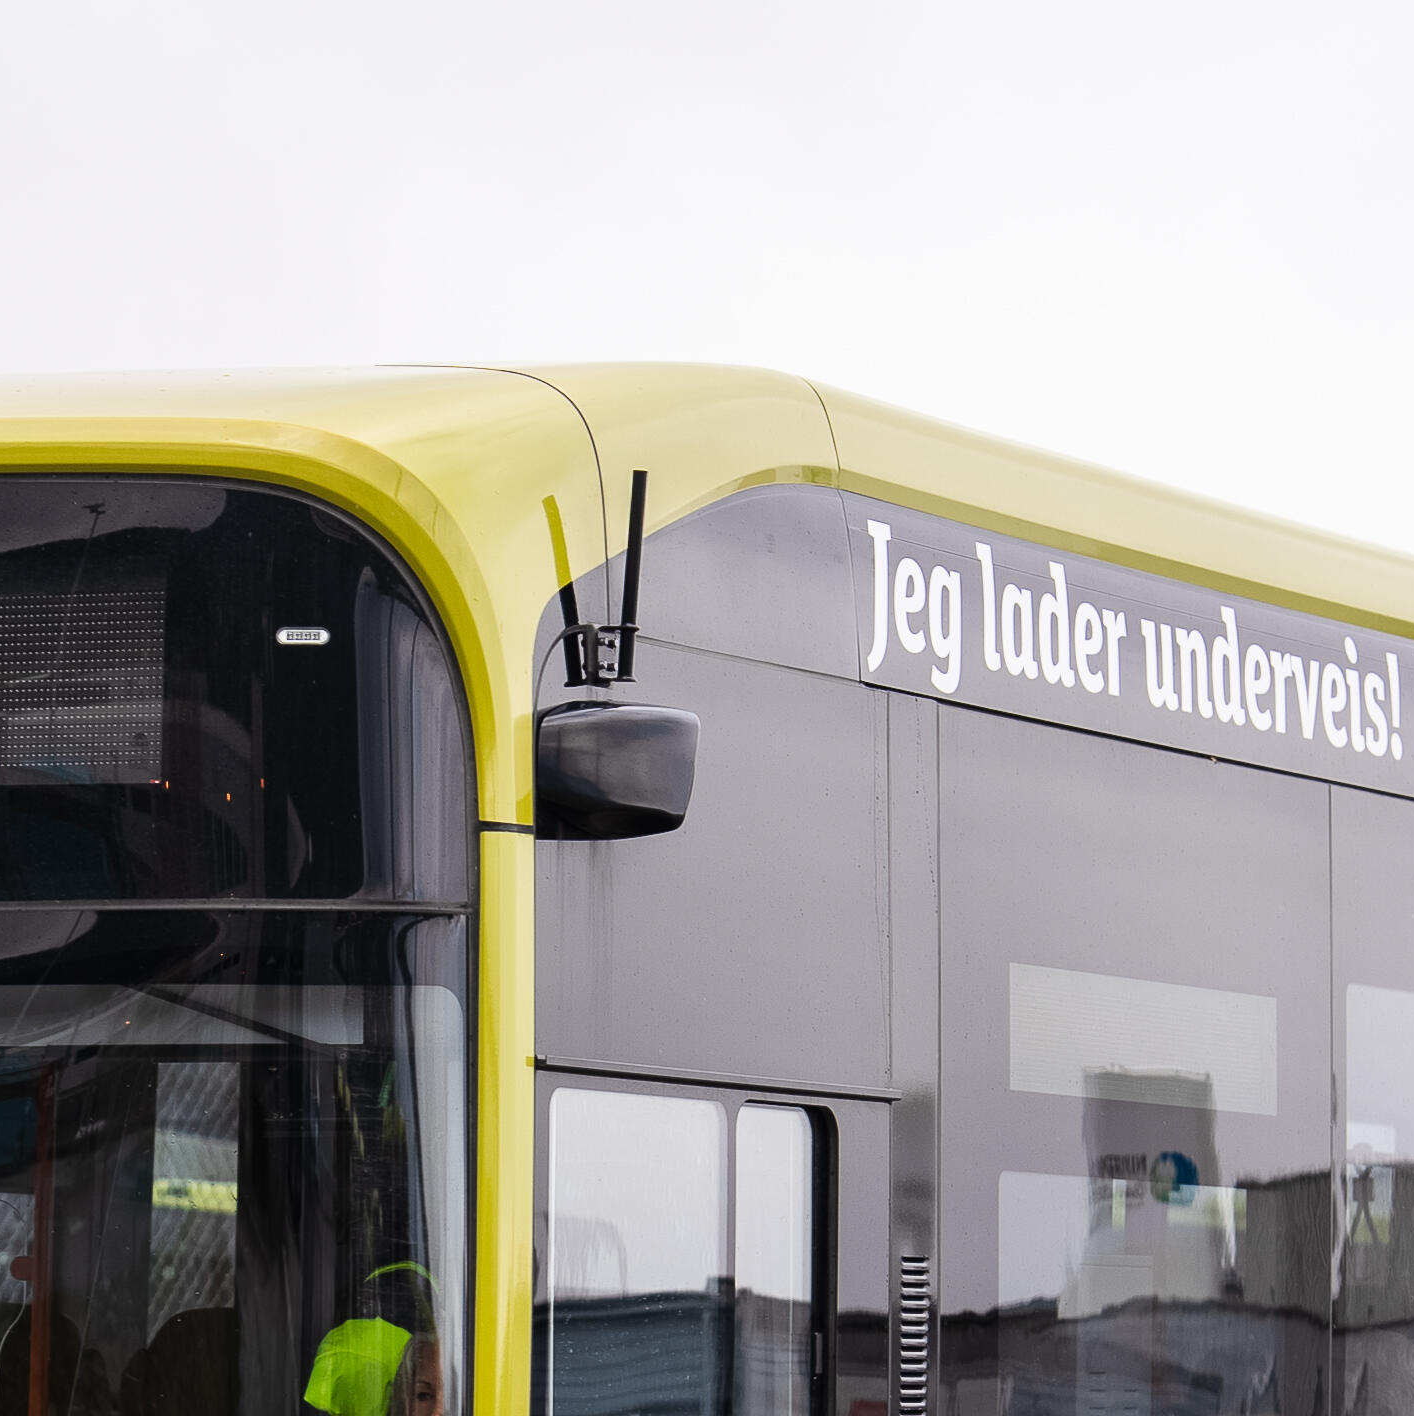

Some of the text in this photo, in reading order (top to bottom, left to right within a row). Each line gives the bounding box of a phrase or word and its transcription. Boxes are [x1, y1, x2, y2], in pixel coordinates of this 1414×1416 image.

[867, 519, 1405, 761] Jeg lader underveis!
